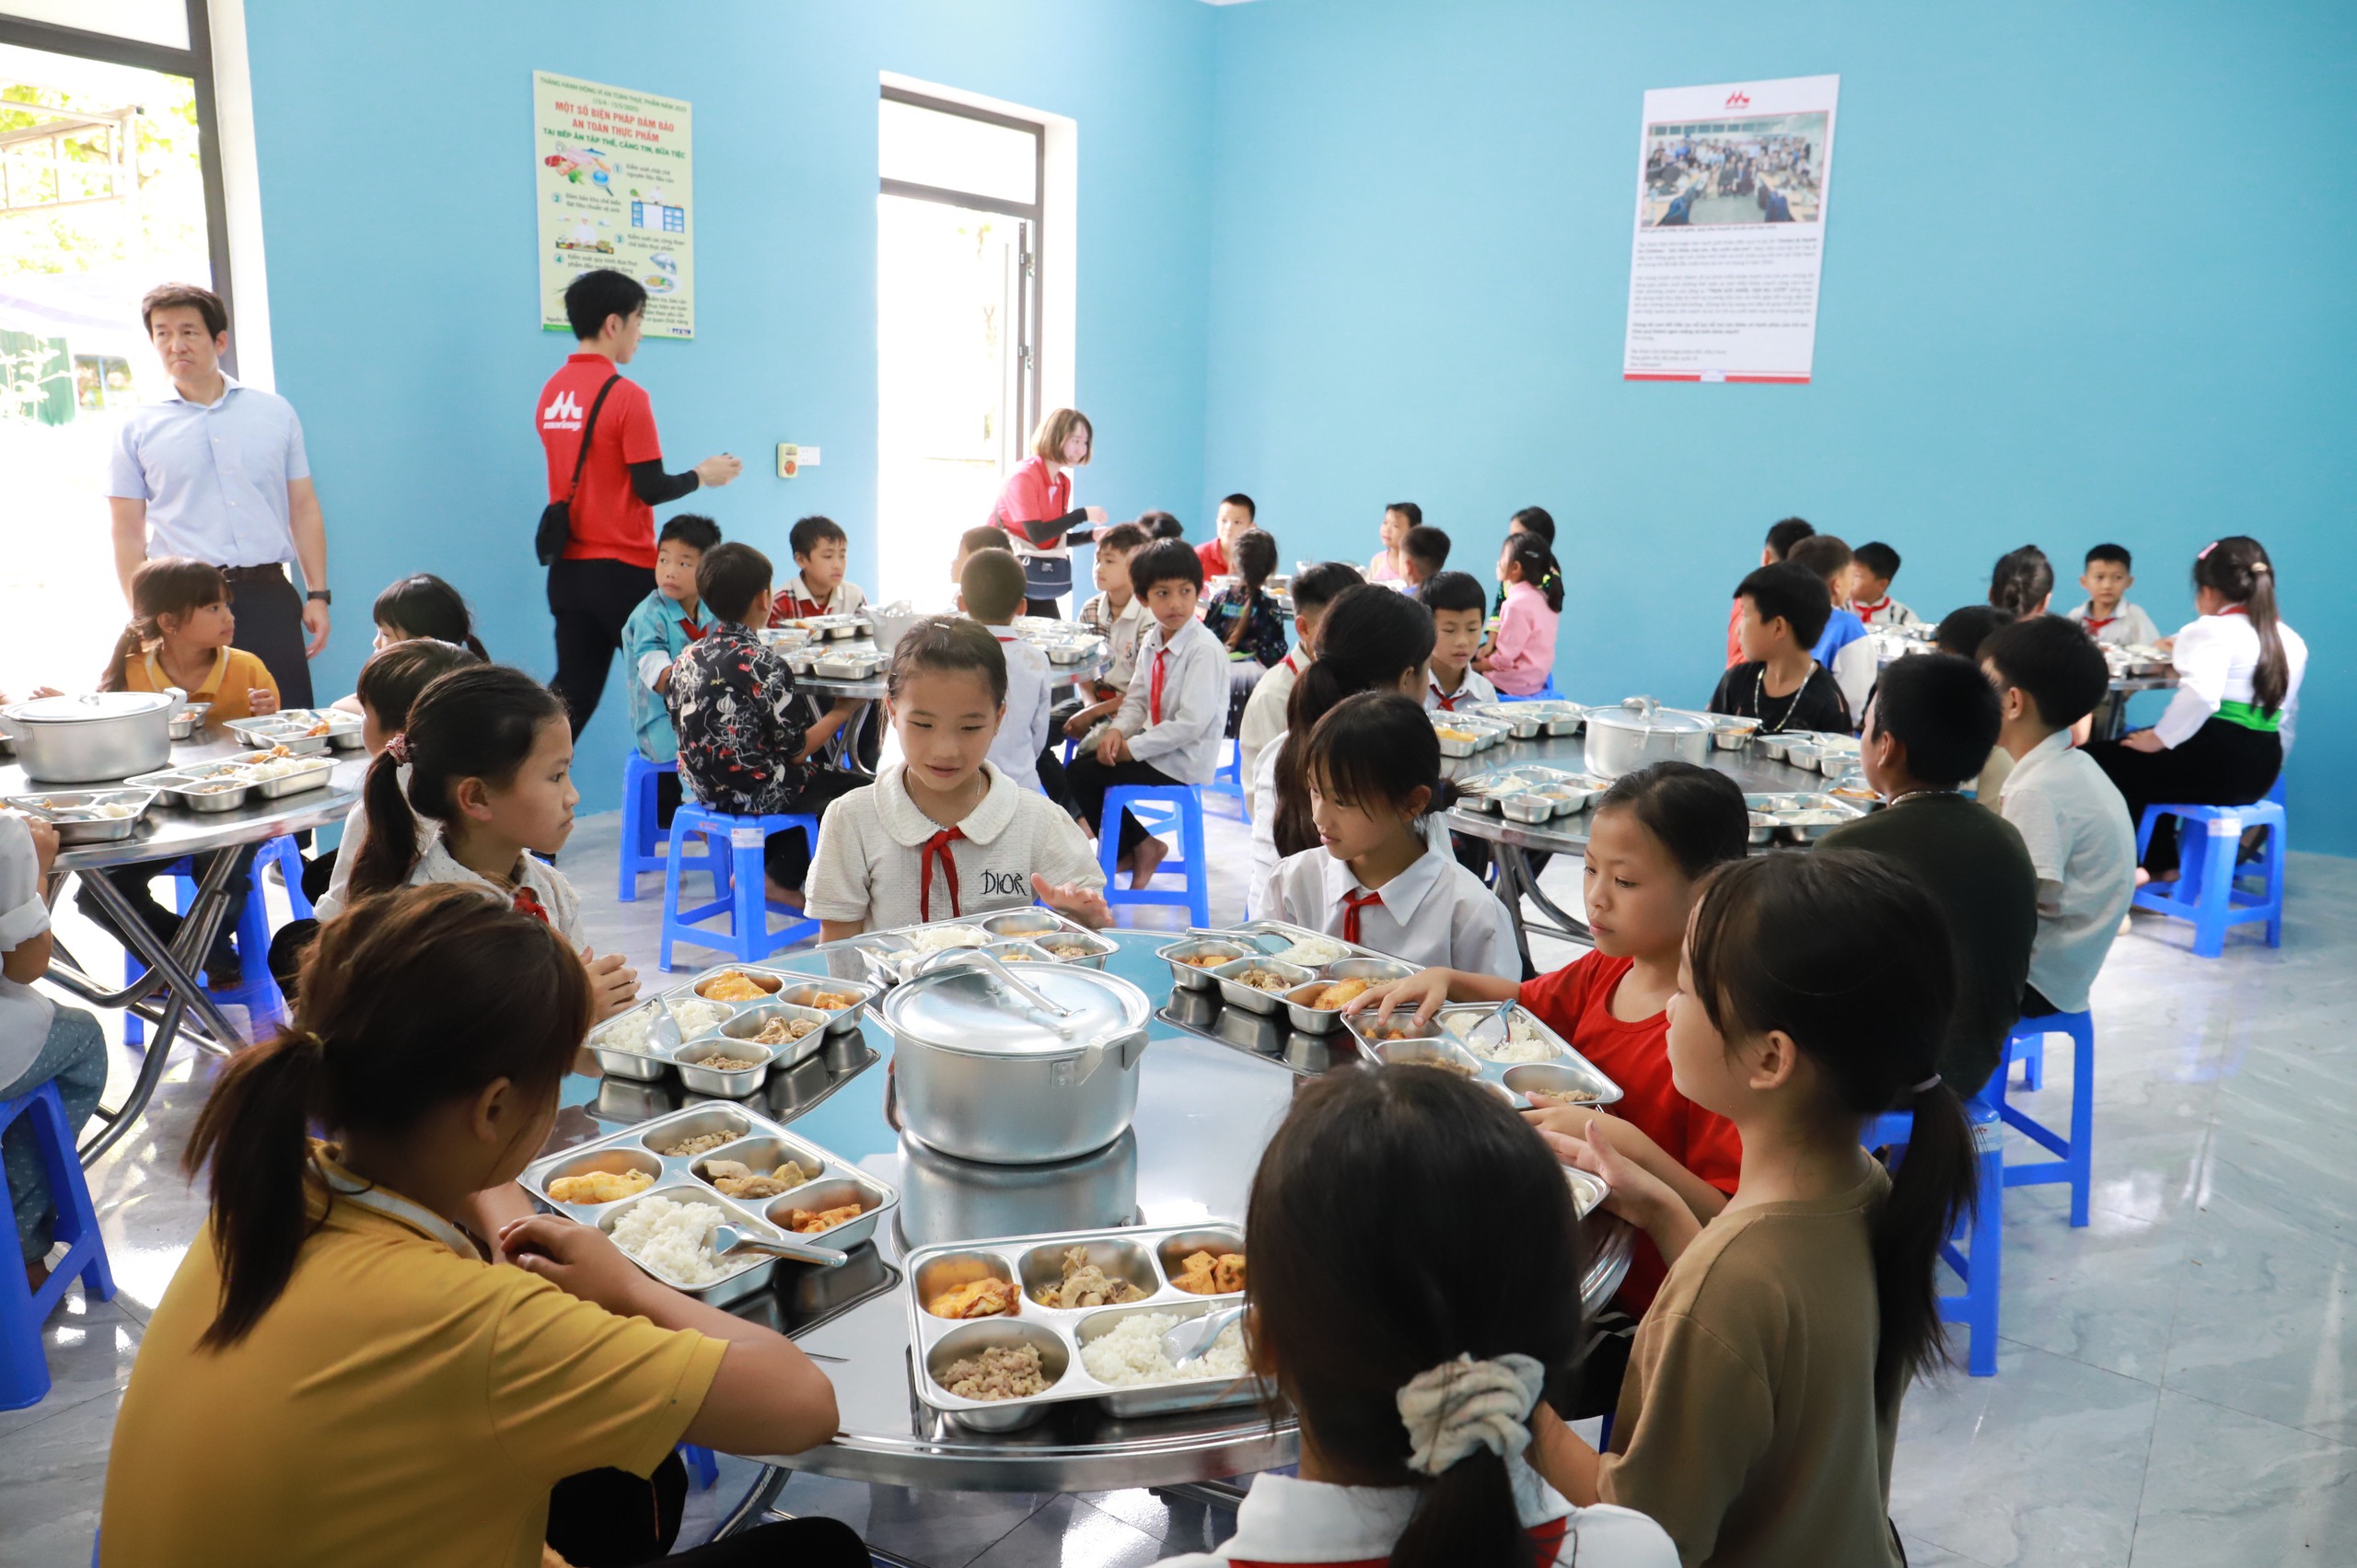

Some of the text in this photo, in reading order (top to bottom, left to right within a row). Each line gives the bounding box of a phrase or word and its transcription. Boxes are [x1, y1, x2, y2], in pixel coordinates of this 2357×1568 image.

[555, 100, 674, 133] MỘT SỐ BIỆN PHÁP ĐẢM BẢO
[572, 119, 659, 142] AN TOÀN THỰC PHẨM
[543, 127, 555, 137] TẠI
[556, 128, 572, 138] BẾP
[574, 131, 585, 141] ĂN
[586, 134, 601, 145] TẬP
[619, 139, 639, 151] CĂNG
[655, 145, 669, 157] BỮA
[670, 147, 686, 159] TIỆC
[980, 869, 1028, 896] DIOR
